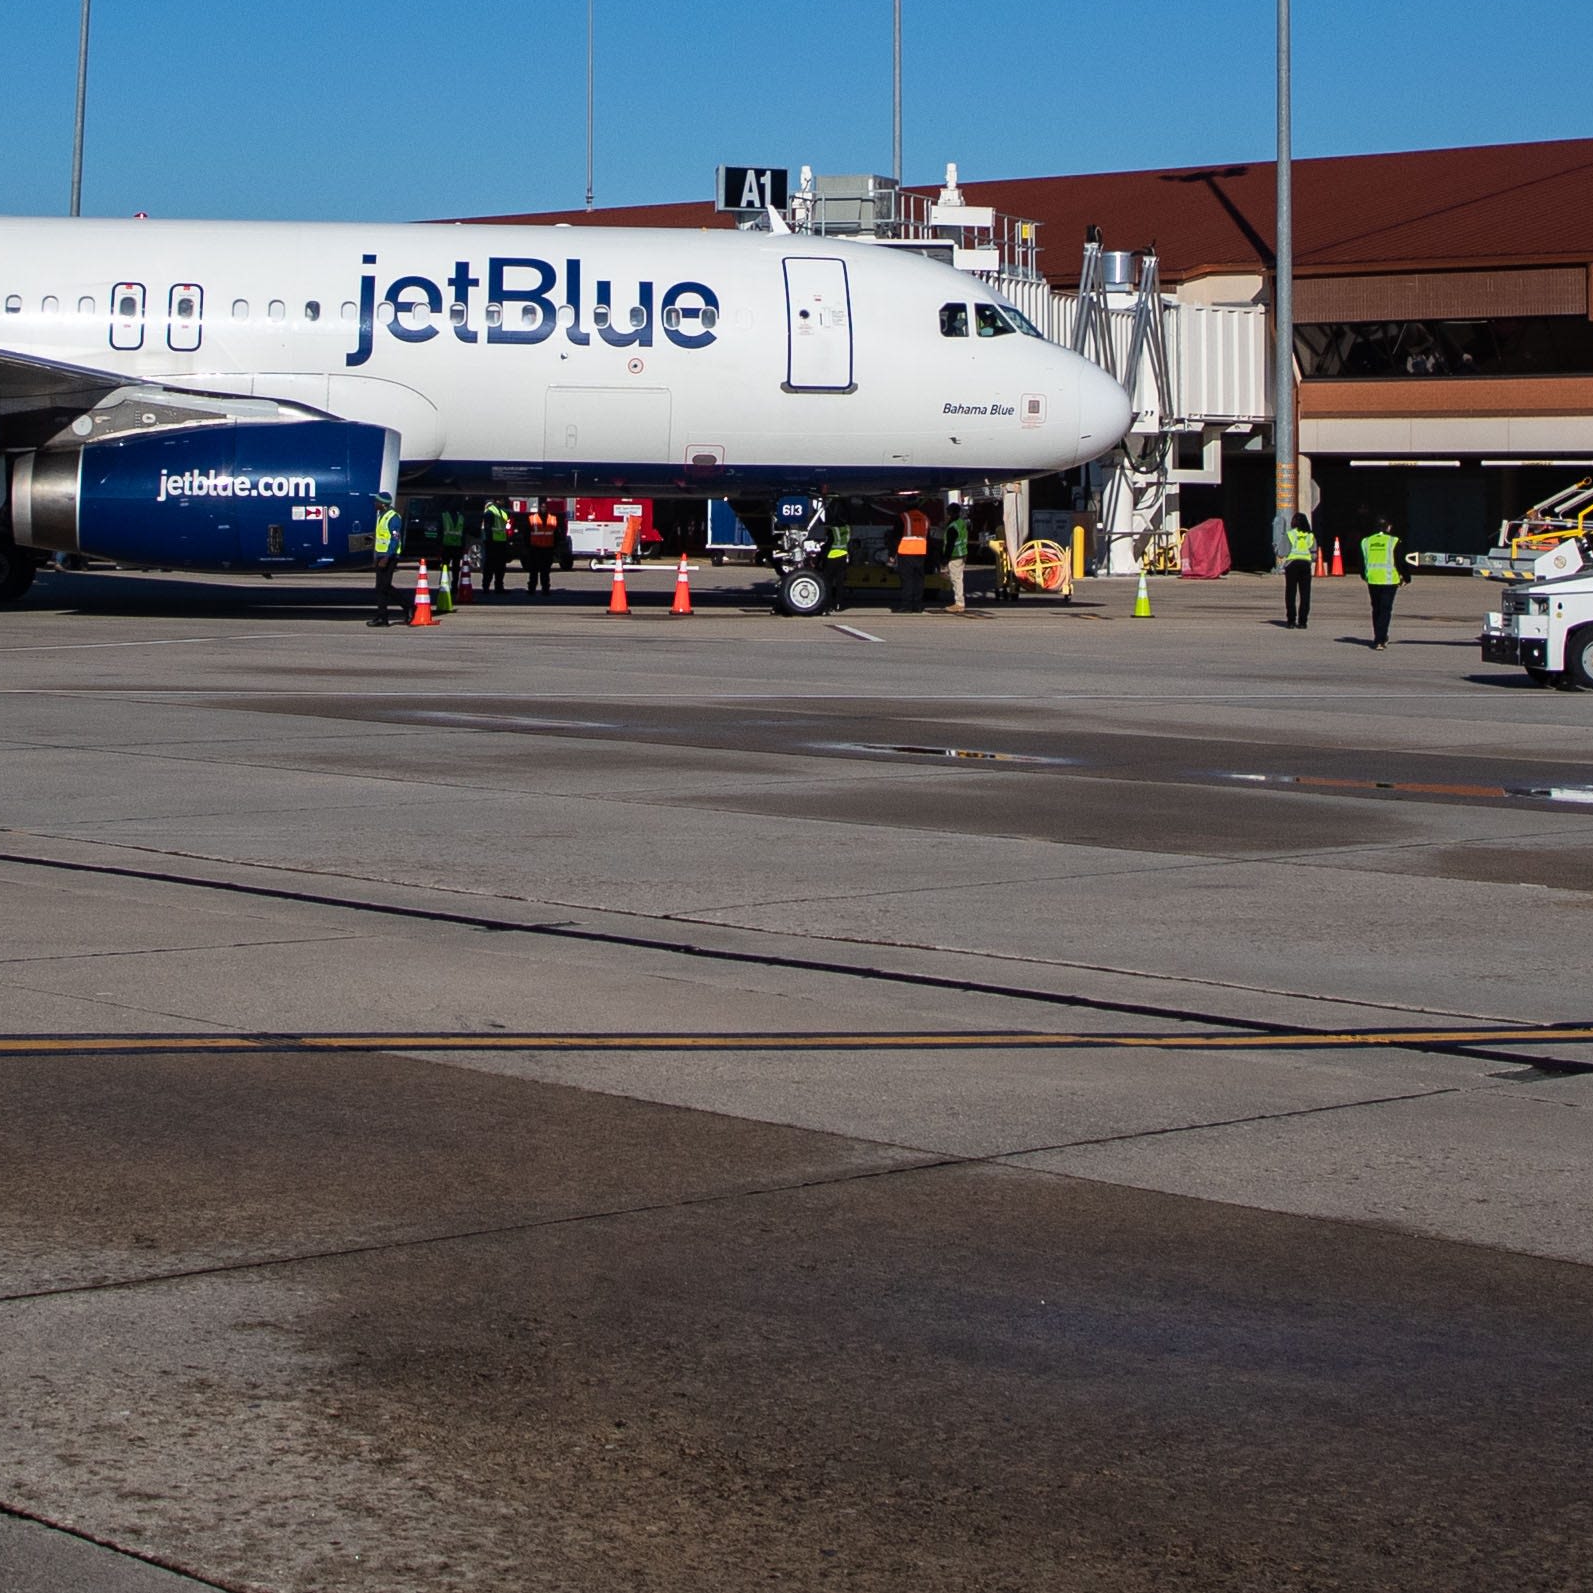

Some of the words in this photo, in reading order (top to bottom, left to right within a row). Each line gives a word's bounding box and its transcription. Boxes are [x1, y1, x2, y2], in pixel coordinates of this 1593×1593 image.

[740, 169, 772, 208] A1
[346, 254, 720, 367] jetBlue
[943, 403, 987, 415] Bahama
[990, 404, 1015, 415] Blue
[157, 469, 316, 501] jetblue.com
[782, 504, 803, 516] 613
